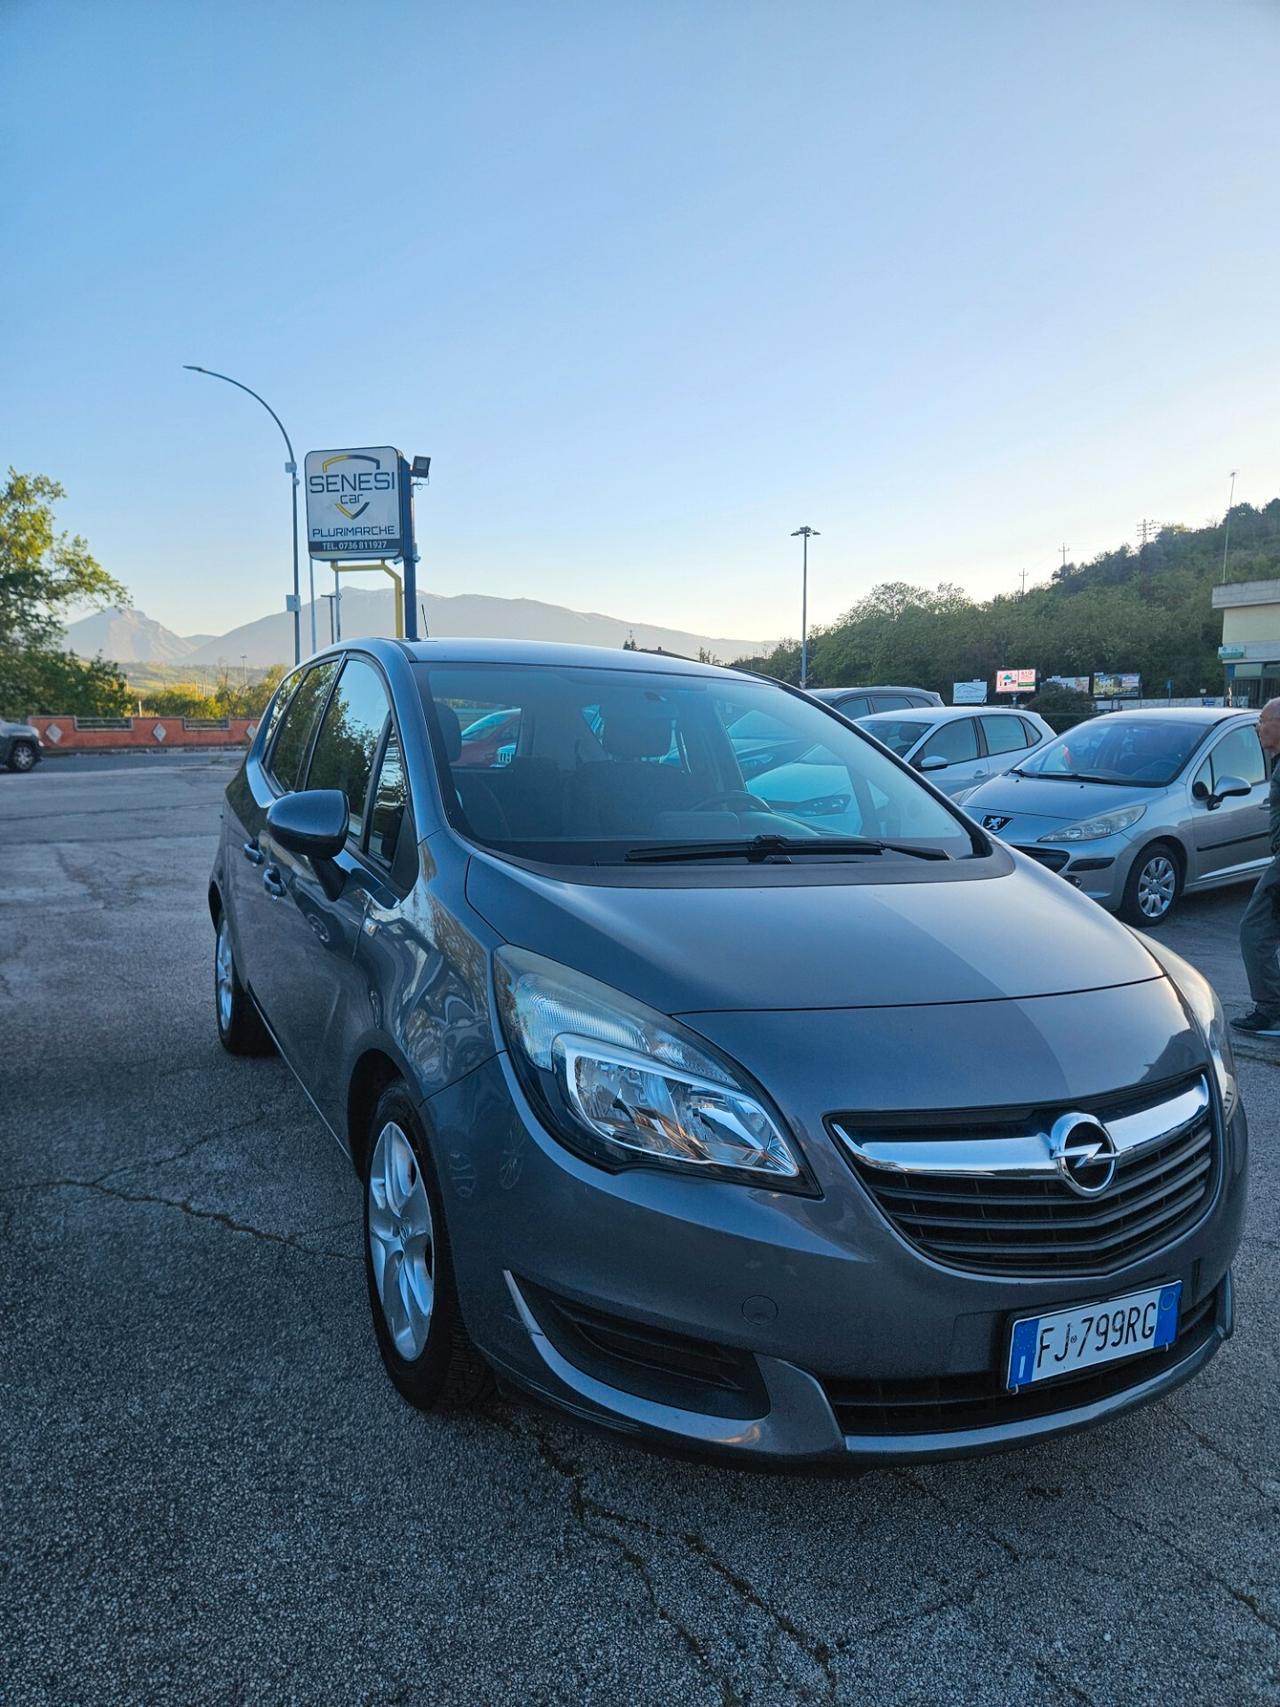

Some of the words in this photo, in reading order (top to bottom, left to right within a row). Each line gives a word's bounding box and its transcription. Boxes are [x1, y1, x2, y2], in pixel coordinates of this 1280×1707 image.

[310, 472, 395, 493] SENESI
[340, 493, 363, 504] car
[313, 526, 395, 537] PLURIMARCHE
[322, 543, 338, 551] TEL.
